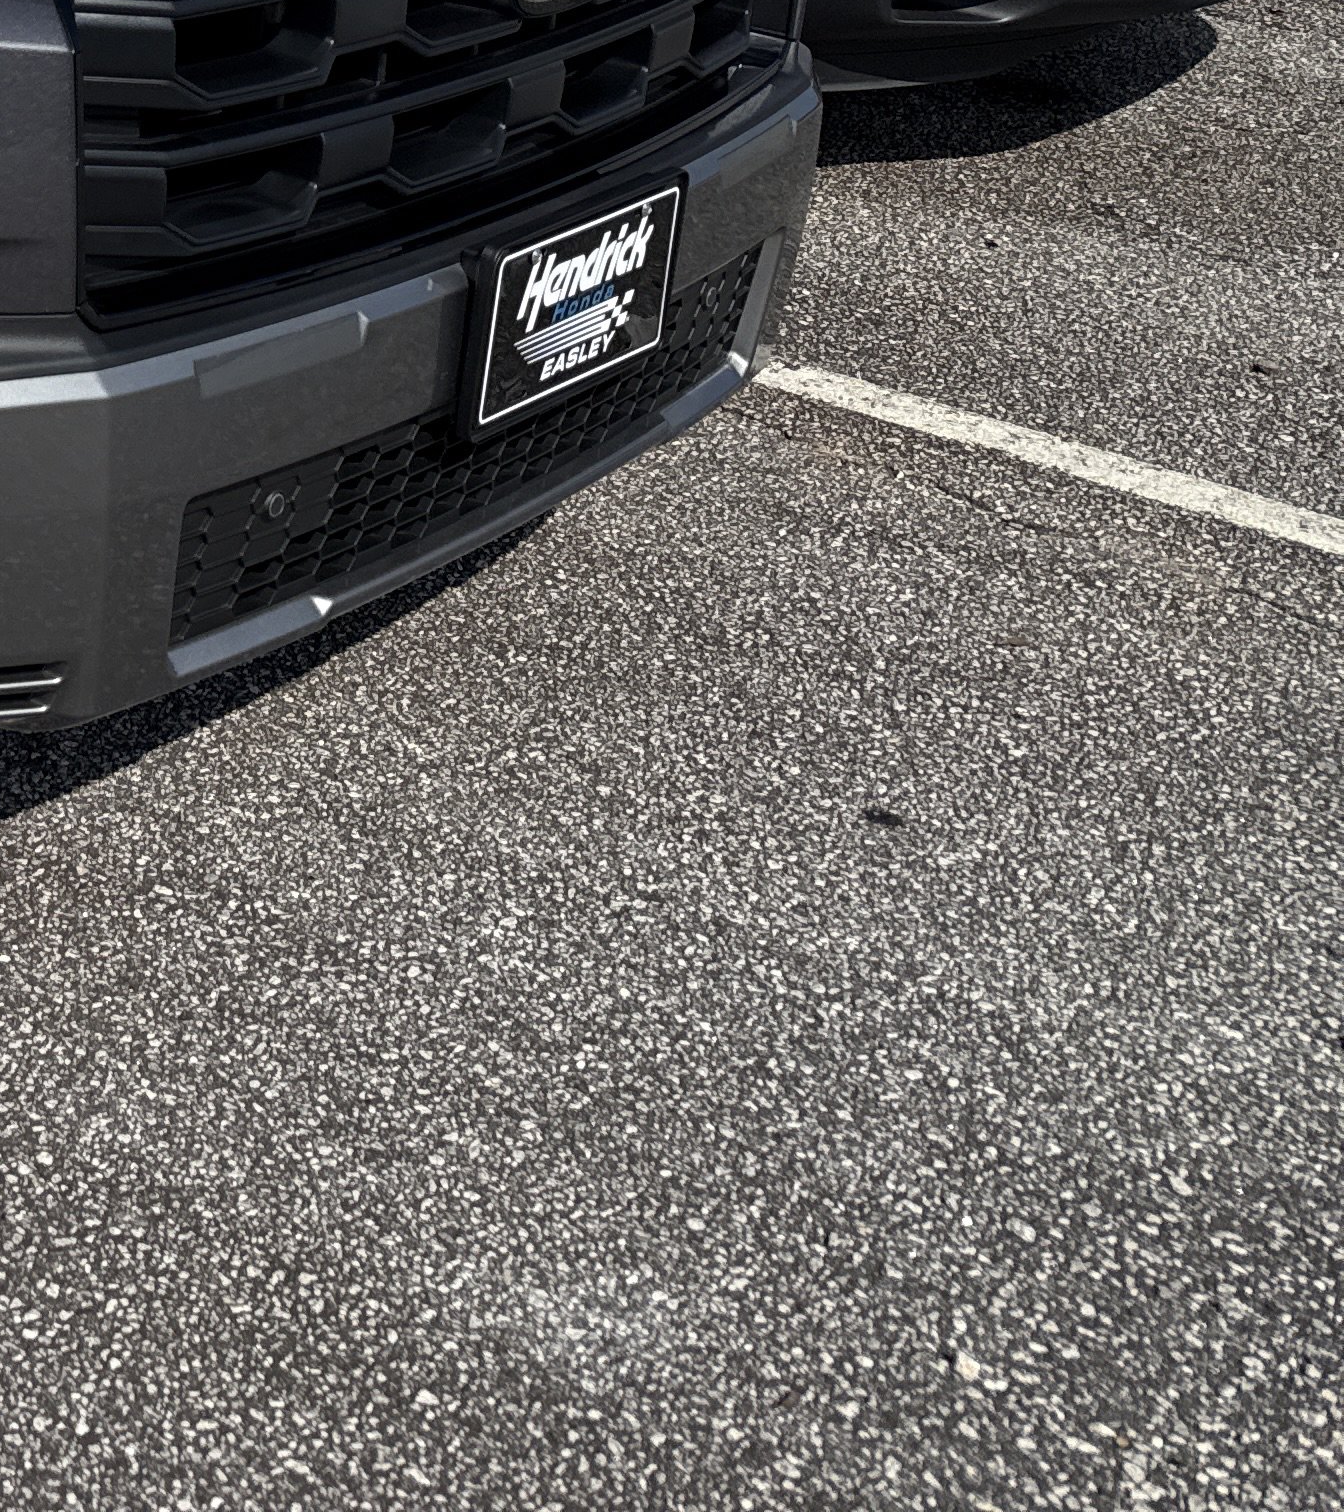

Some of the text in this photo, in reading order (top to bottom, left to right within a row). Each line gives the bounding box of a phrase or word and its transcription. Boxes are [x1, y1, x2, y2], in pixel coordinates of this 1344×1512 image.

[516, 216, 655, 334] Hendrick
[551, 283, 615, 324] Honda
[539, 330, 616, 382] EASLEY
